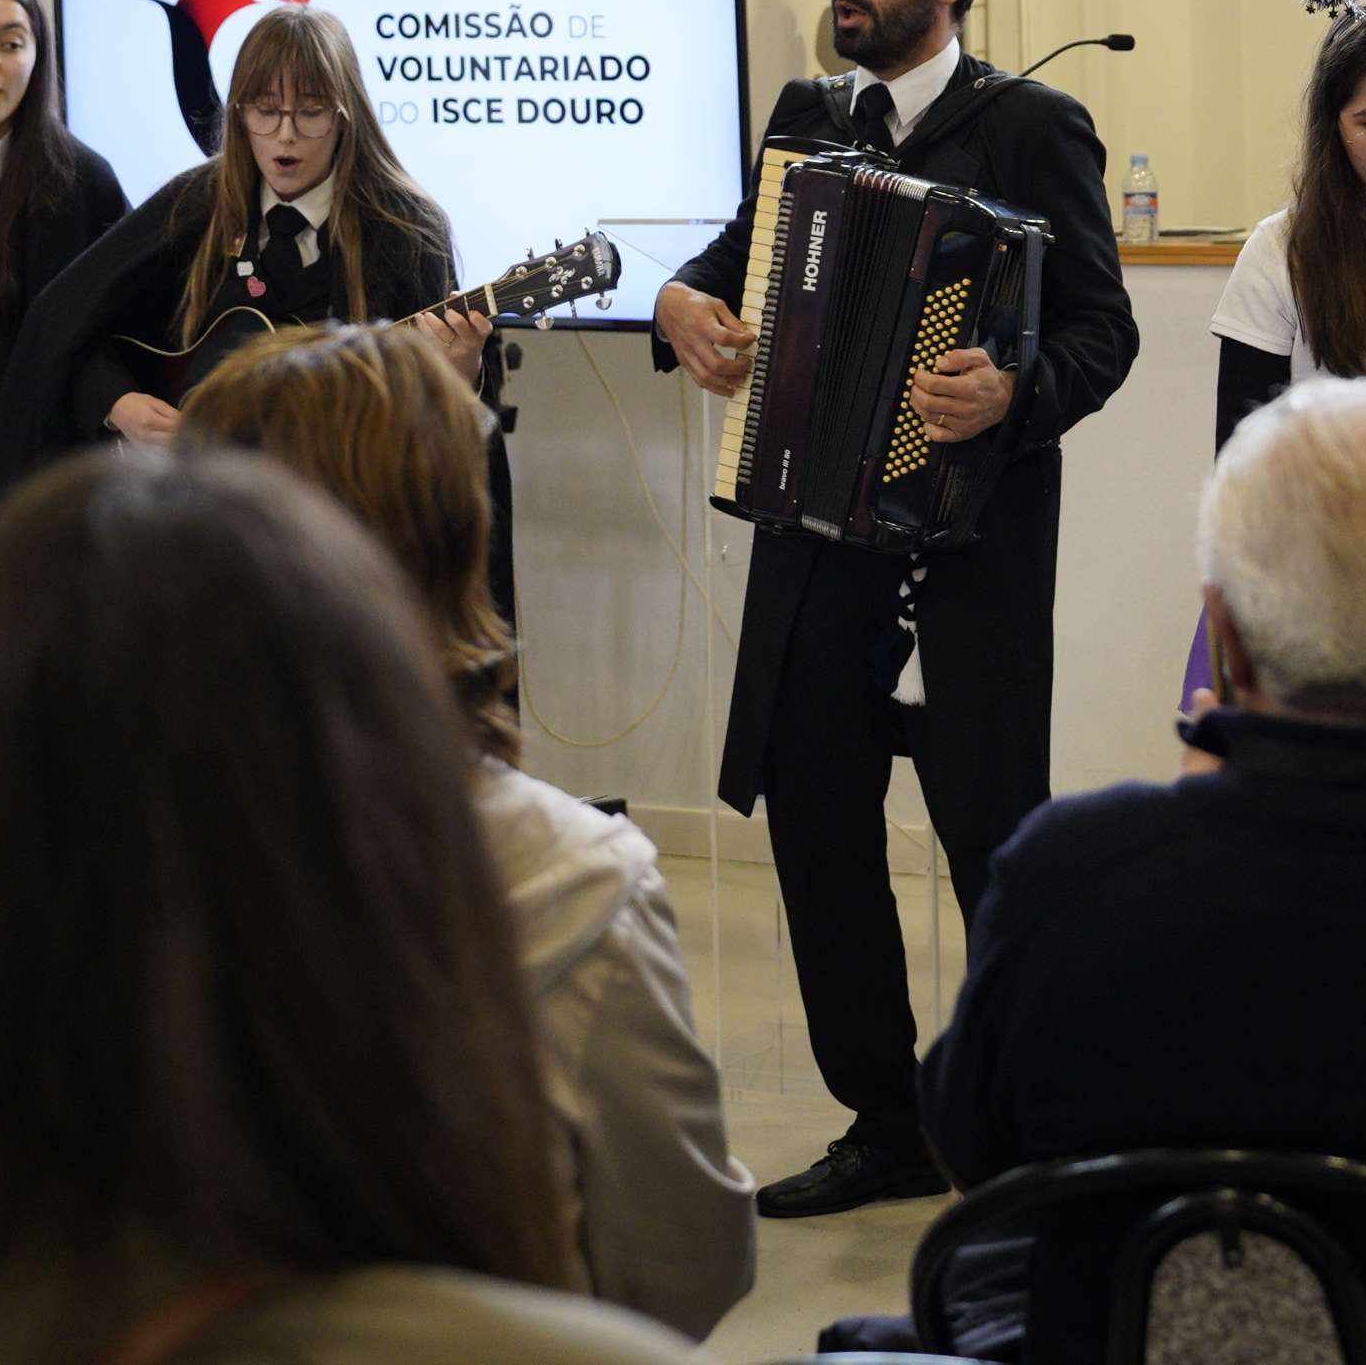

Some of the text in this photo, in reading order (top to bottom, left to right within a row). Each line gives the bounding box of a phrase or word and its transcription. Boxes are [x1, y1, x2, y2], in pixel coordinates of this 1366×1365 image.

[375, 4, 606, 40] COMISSÃO DE
[377, 55, 652, 83] VOLUNTARIADO
[379, 98, 644, 125] DO ISCE DOURO
[803, 210, 829, 292] HOHNER
[783, 449, 791, 459] 80
[779, 468, 788, 491] bravo
